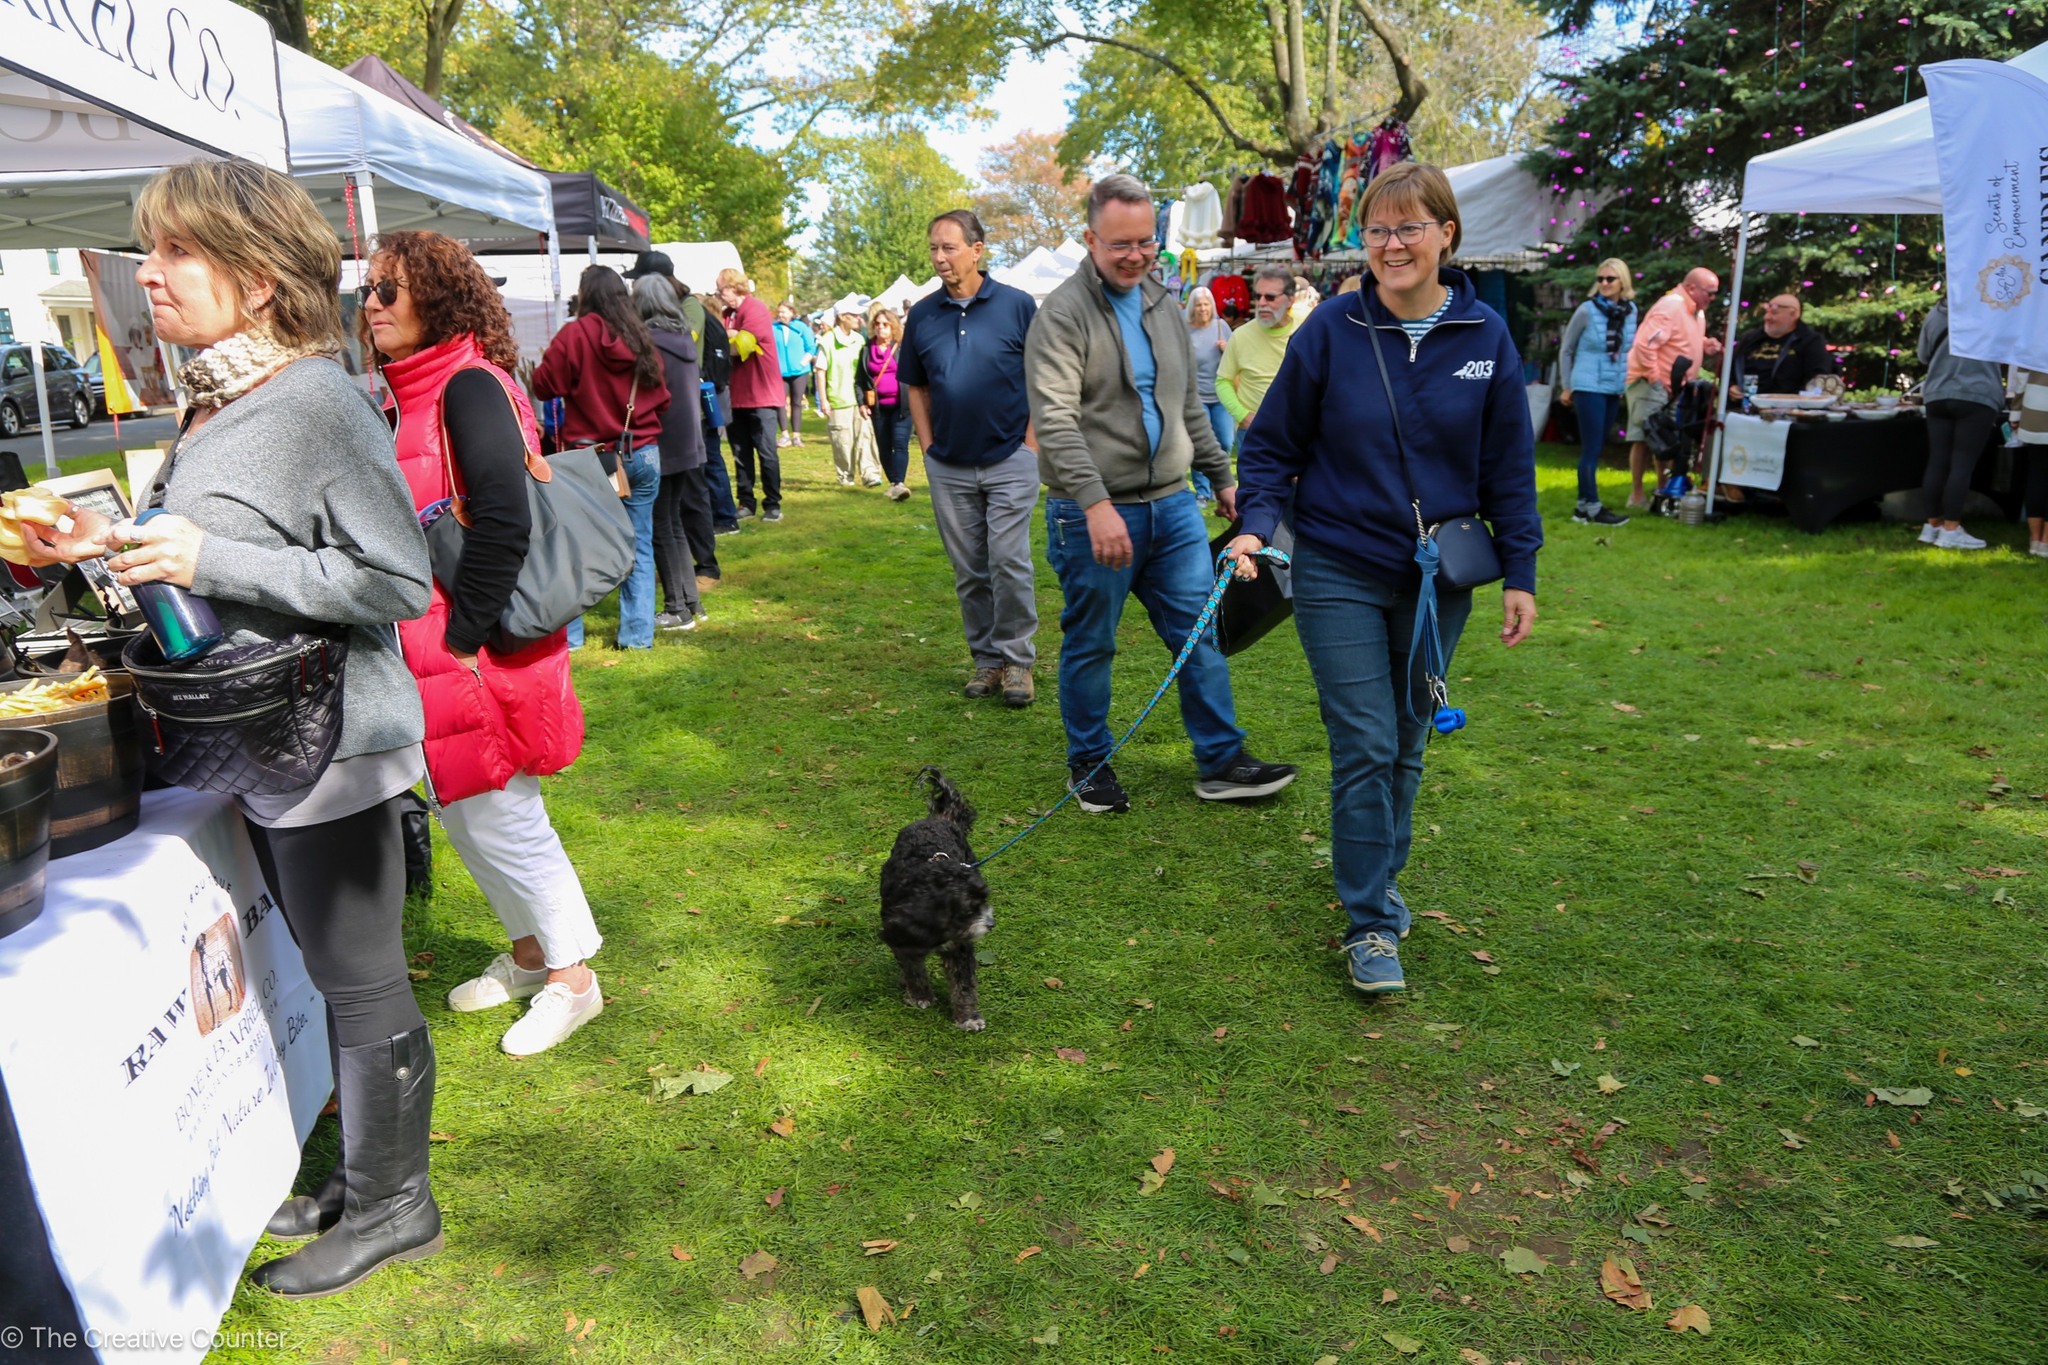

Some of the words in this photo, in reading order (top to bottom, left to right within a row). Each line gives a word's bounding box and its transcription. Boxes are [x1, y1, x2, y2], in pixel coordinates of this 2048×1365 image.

[167, 7, 241, 120] CO.
[1987, 176, 2004, 187] of
[2003, 160, 2027, 249] Empowerment
[1985, 194, 2007, 234] Scents
[1465, 360, 1493, 377] 203
[120, 986, 187, 1089] RAW
[242, 893, 277, 940] BA
